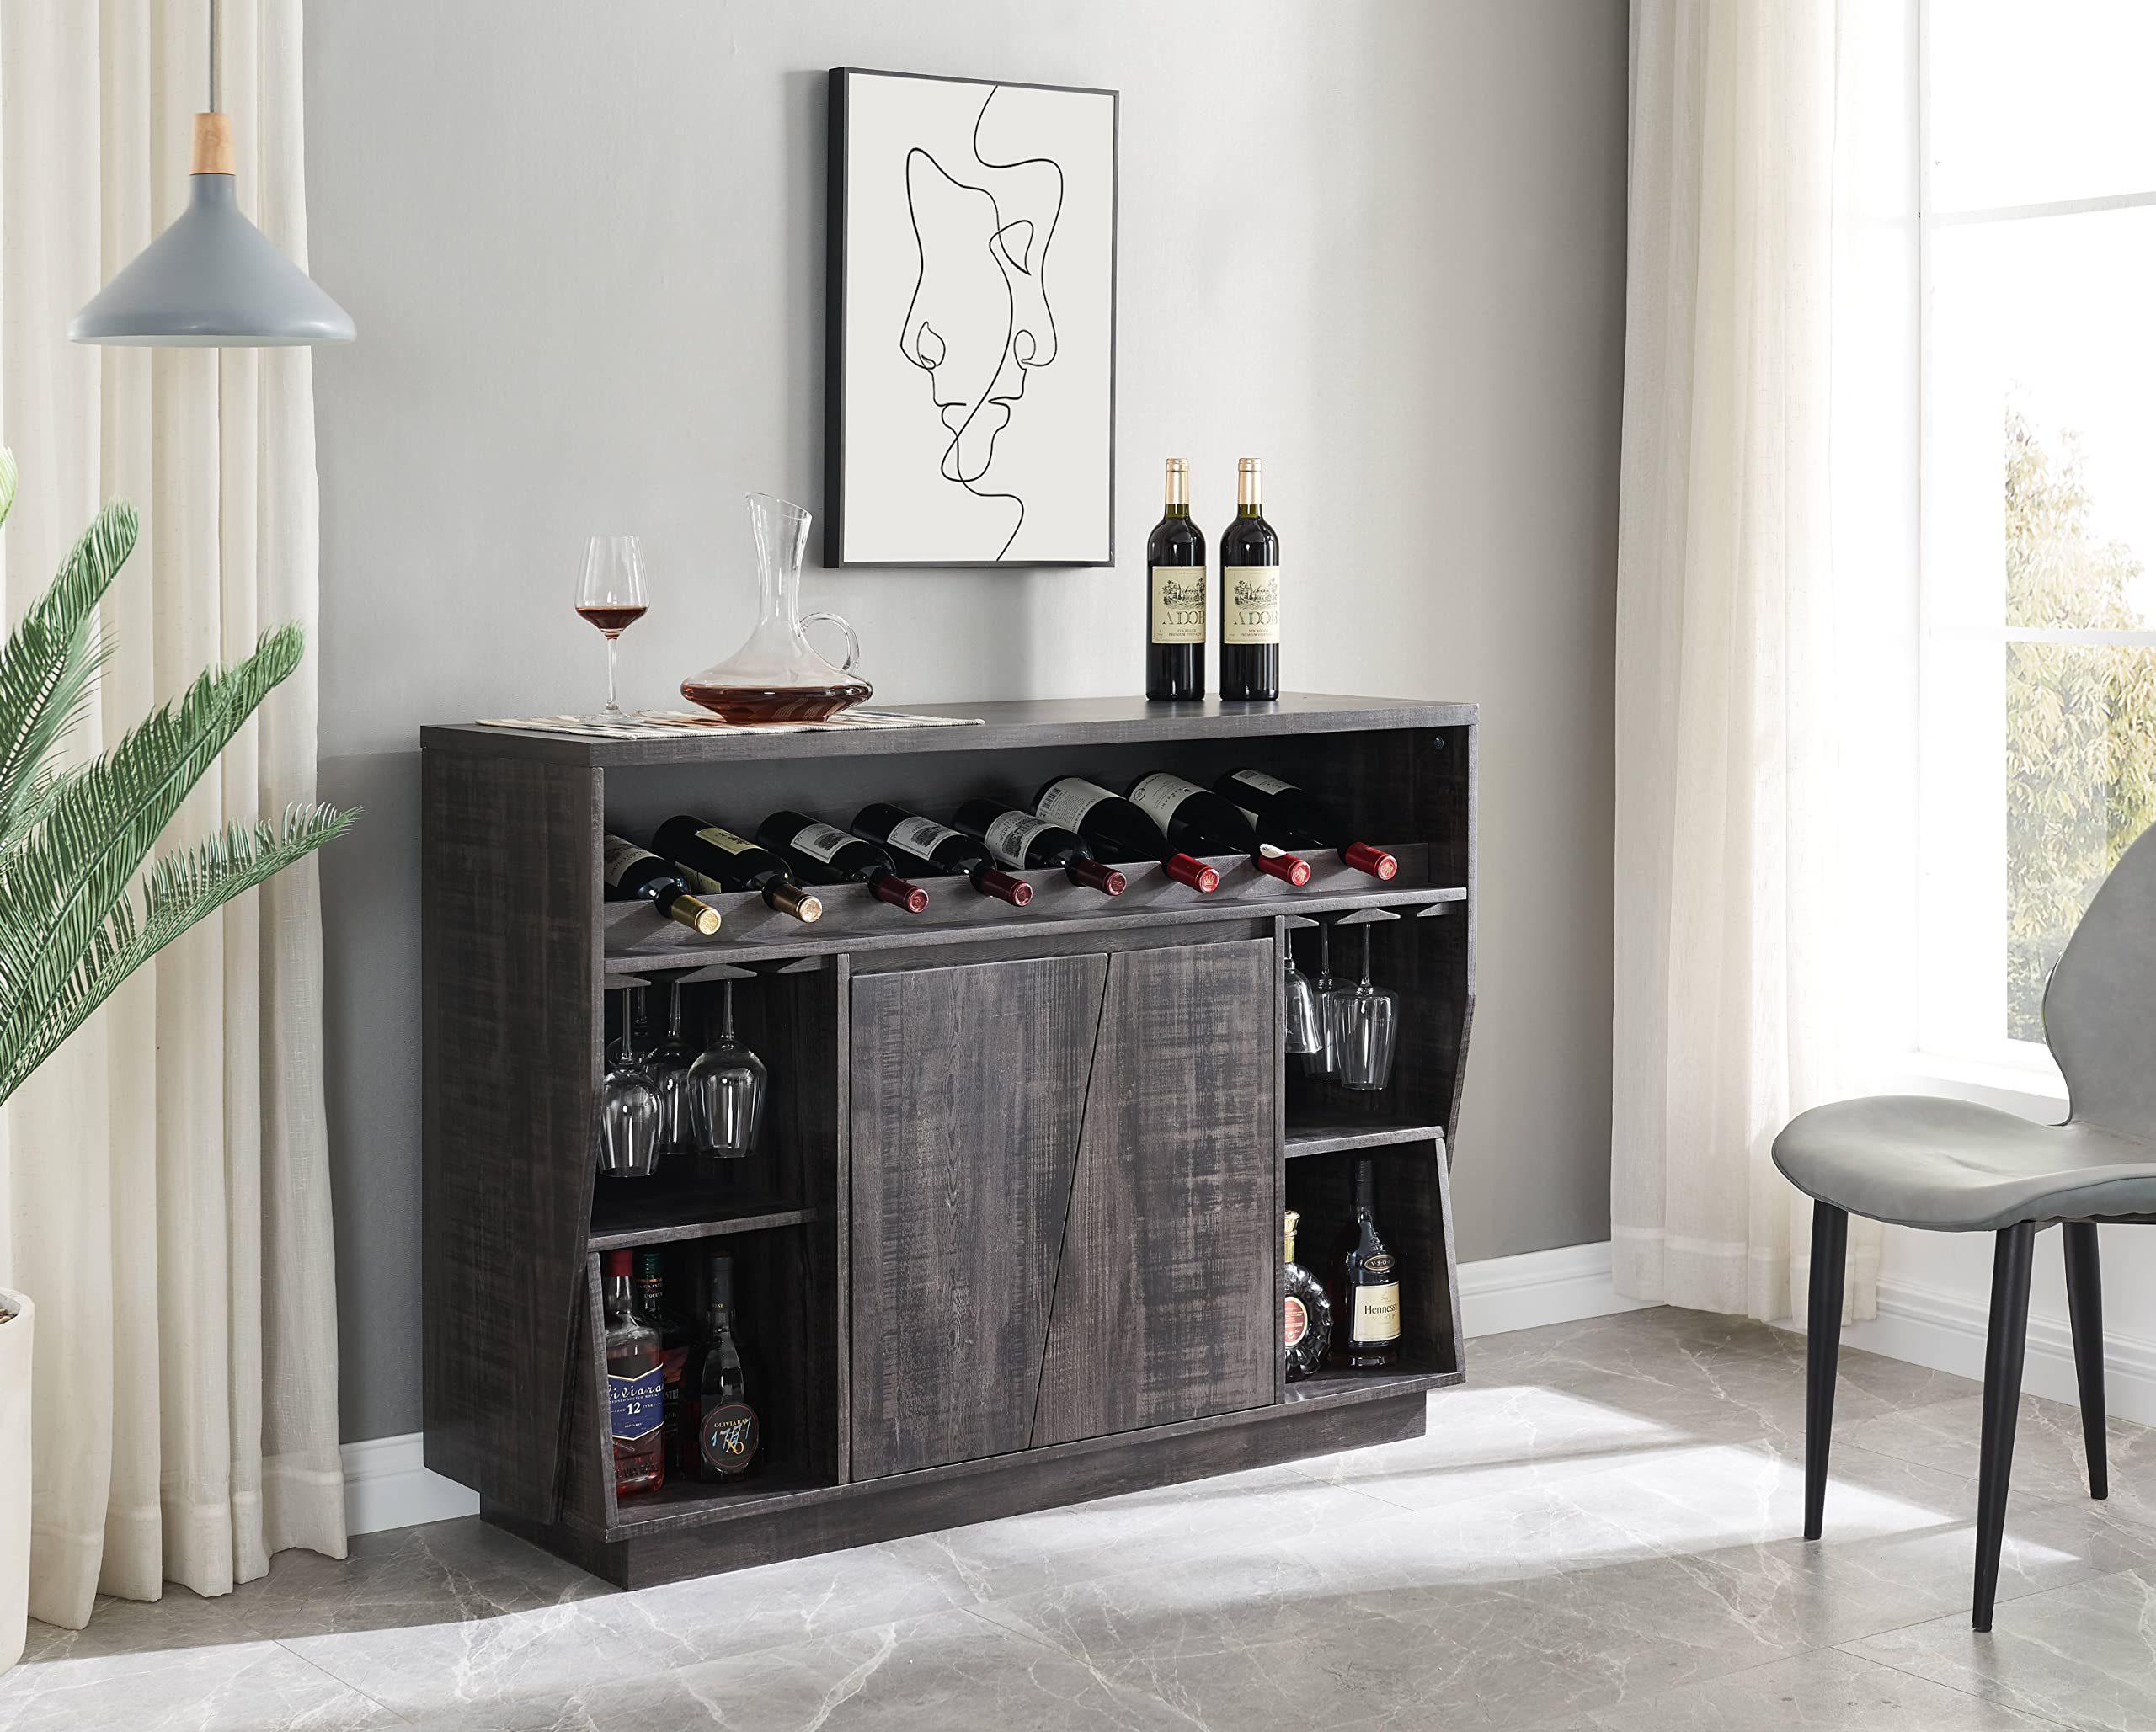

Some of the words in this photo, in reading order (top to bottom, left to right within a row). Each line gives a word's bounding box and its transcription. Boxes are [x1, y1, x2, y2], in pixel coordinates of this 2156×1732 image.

[1364, 1303, 1397, 1314] Hennessy
[627, 1402, 641, 1415] 12
[723, 1437, 745, 1455] XO
